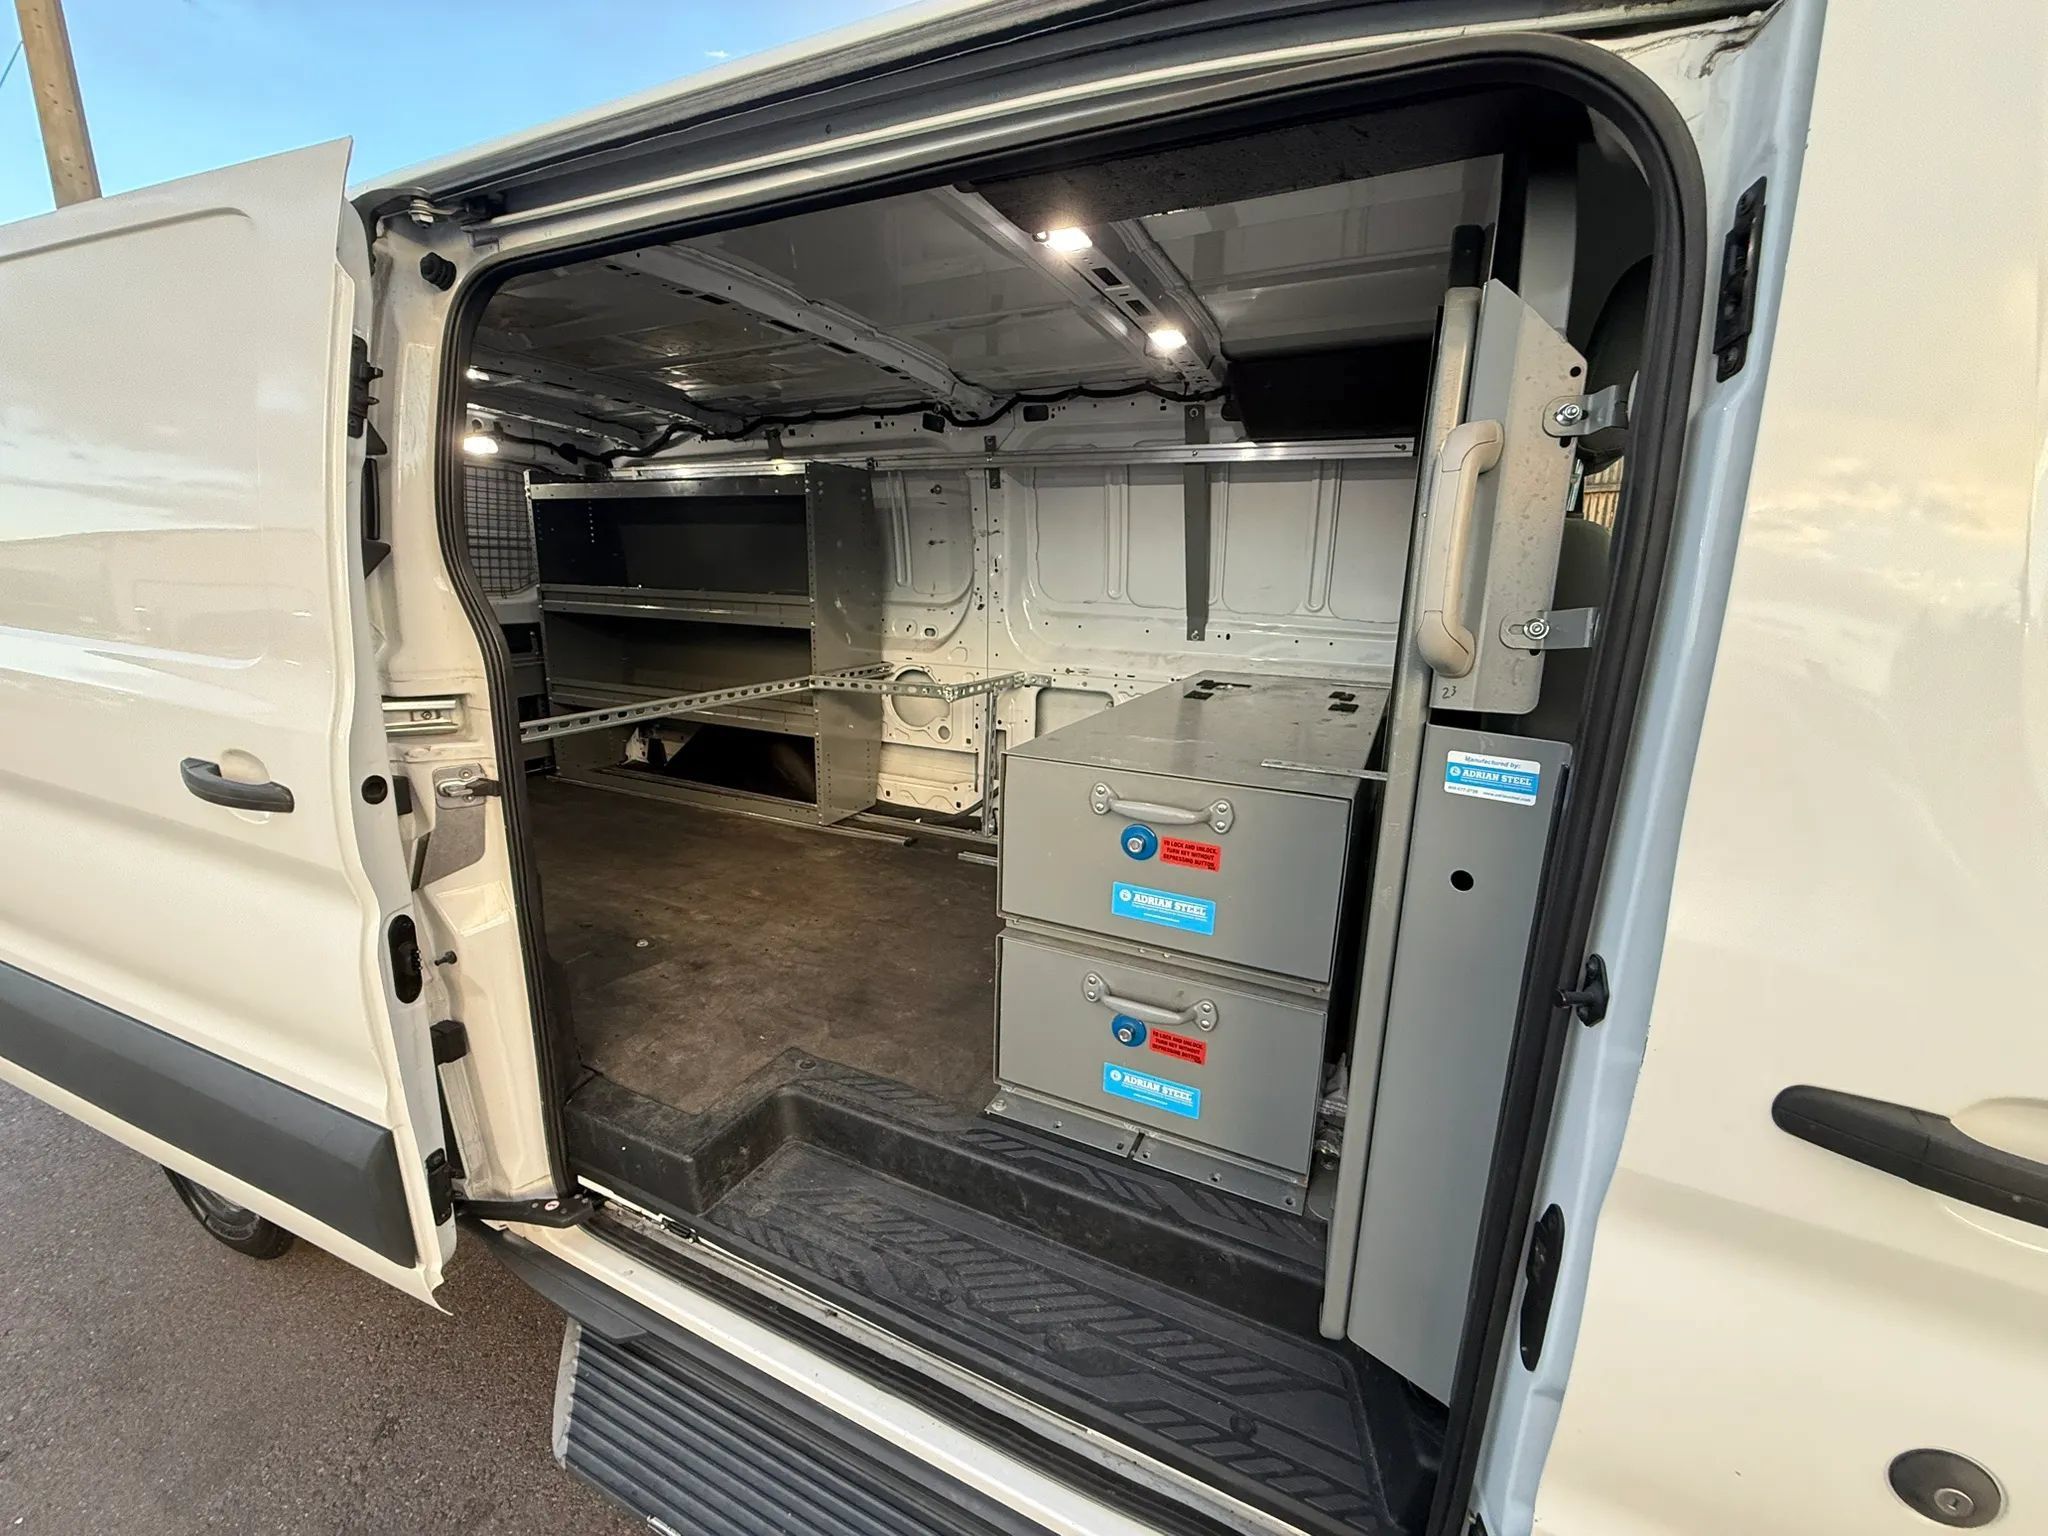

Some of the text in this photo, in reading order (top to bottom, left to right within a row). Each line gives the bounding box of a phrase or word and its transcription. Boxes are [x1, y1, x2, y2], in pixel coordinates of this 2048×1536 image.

[1442, 685, 1457, 699] 23
[1464, 756, 1509, 767] Manufactured
[1462, 770, 1500, 781] ADRIAN
[1501, 776, 1532, 785] STEEL
[1133, 894, 1173, 908] ADRIAN
[1174, 902, 1207, 915] STEEL
[1123, 1076, 1161, 1091] ADRIAN
[1161, 1086, 1193, 1100] STEEL
